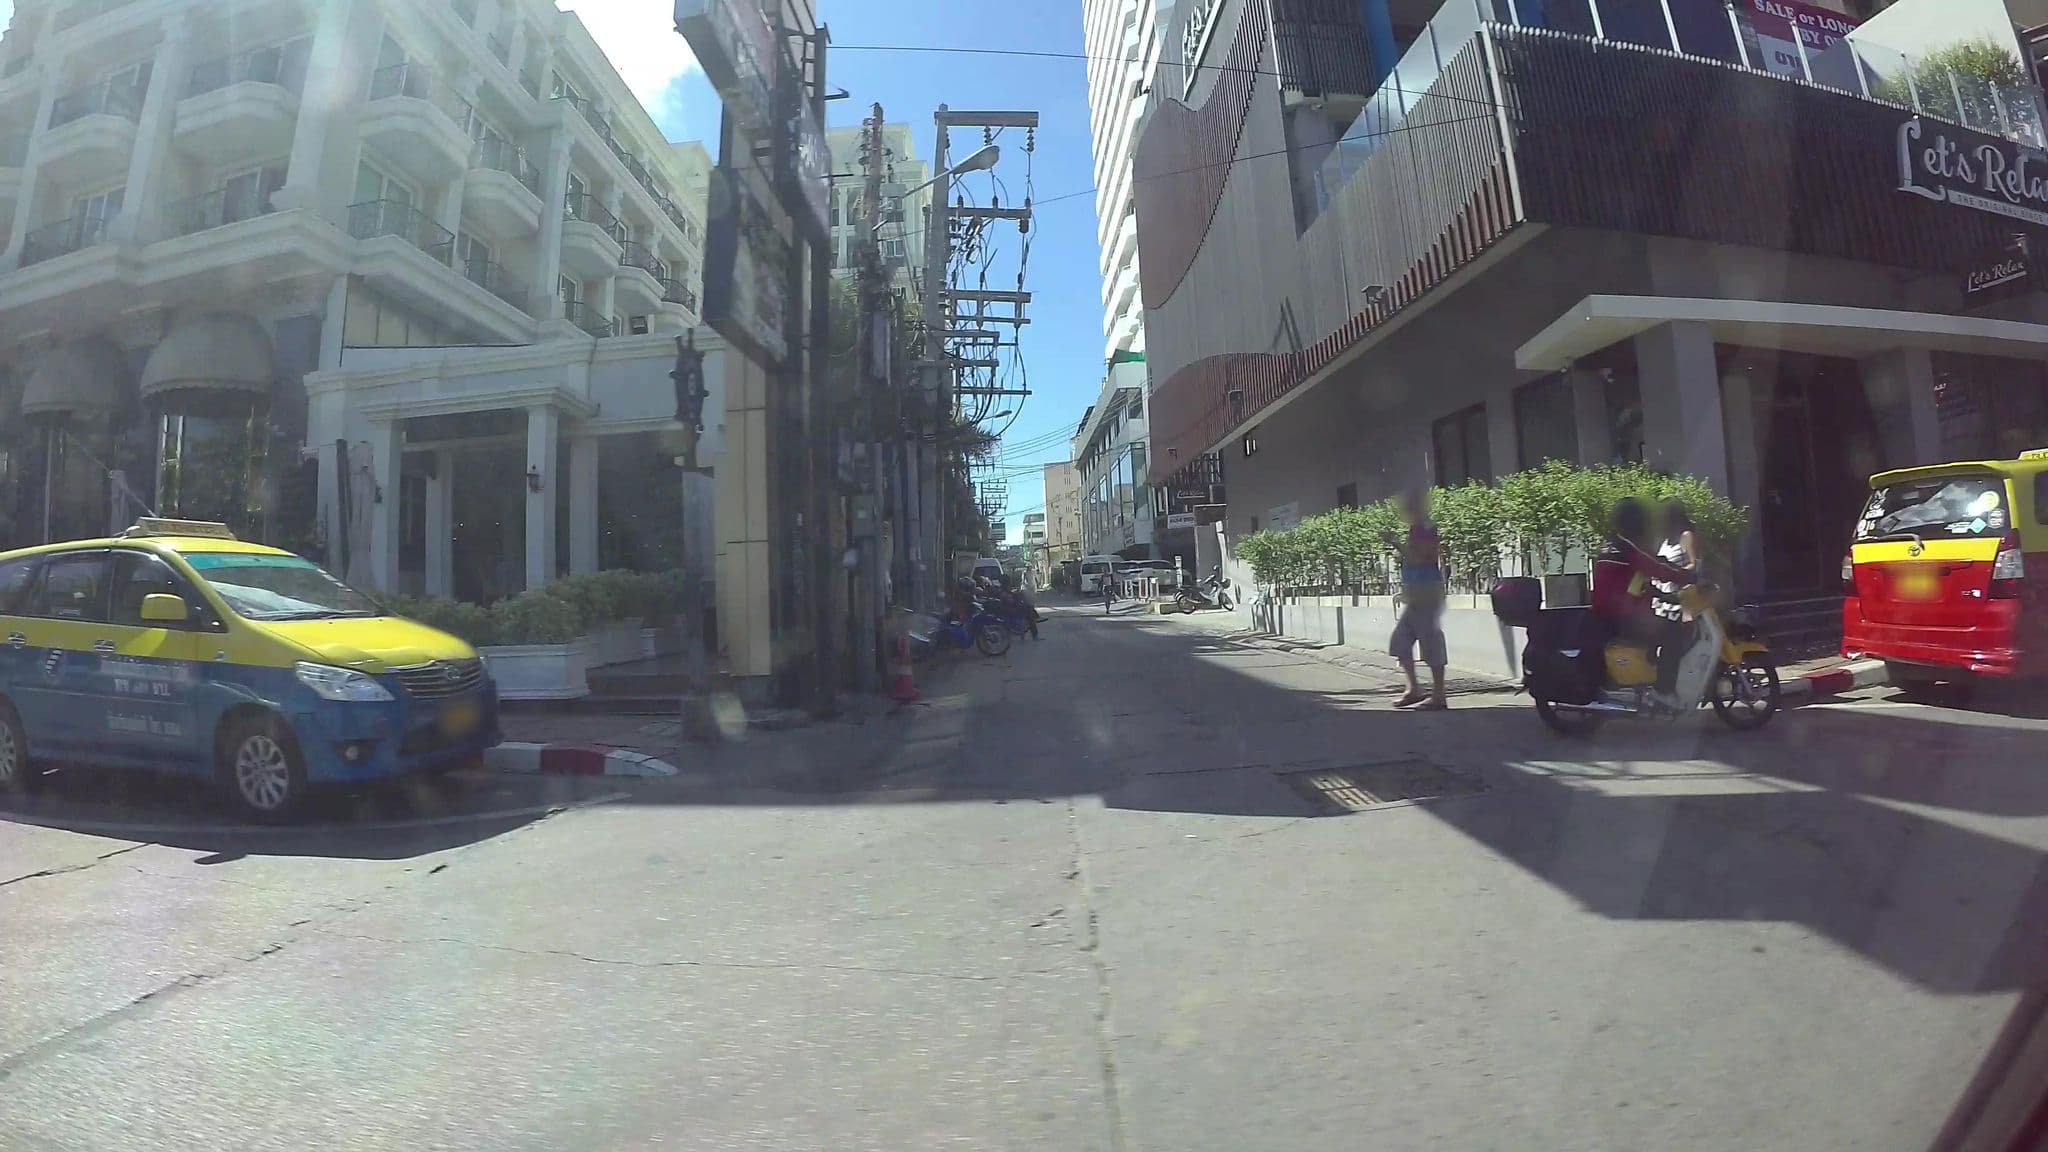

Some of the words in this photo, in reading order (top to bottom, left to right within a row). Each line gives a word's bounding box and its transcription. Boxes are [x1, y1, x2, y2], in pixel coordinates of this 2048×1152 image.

[1754, 0, 1796, 19] SALE
[1799, 13, 1815, 25] or
[1799, 27, 1820, 44] BY
[1897, 119, 1977, 200] Let's
[1968, 271, 1992, 293] Let's
[1991, 259, 2025, 280] Relax
